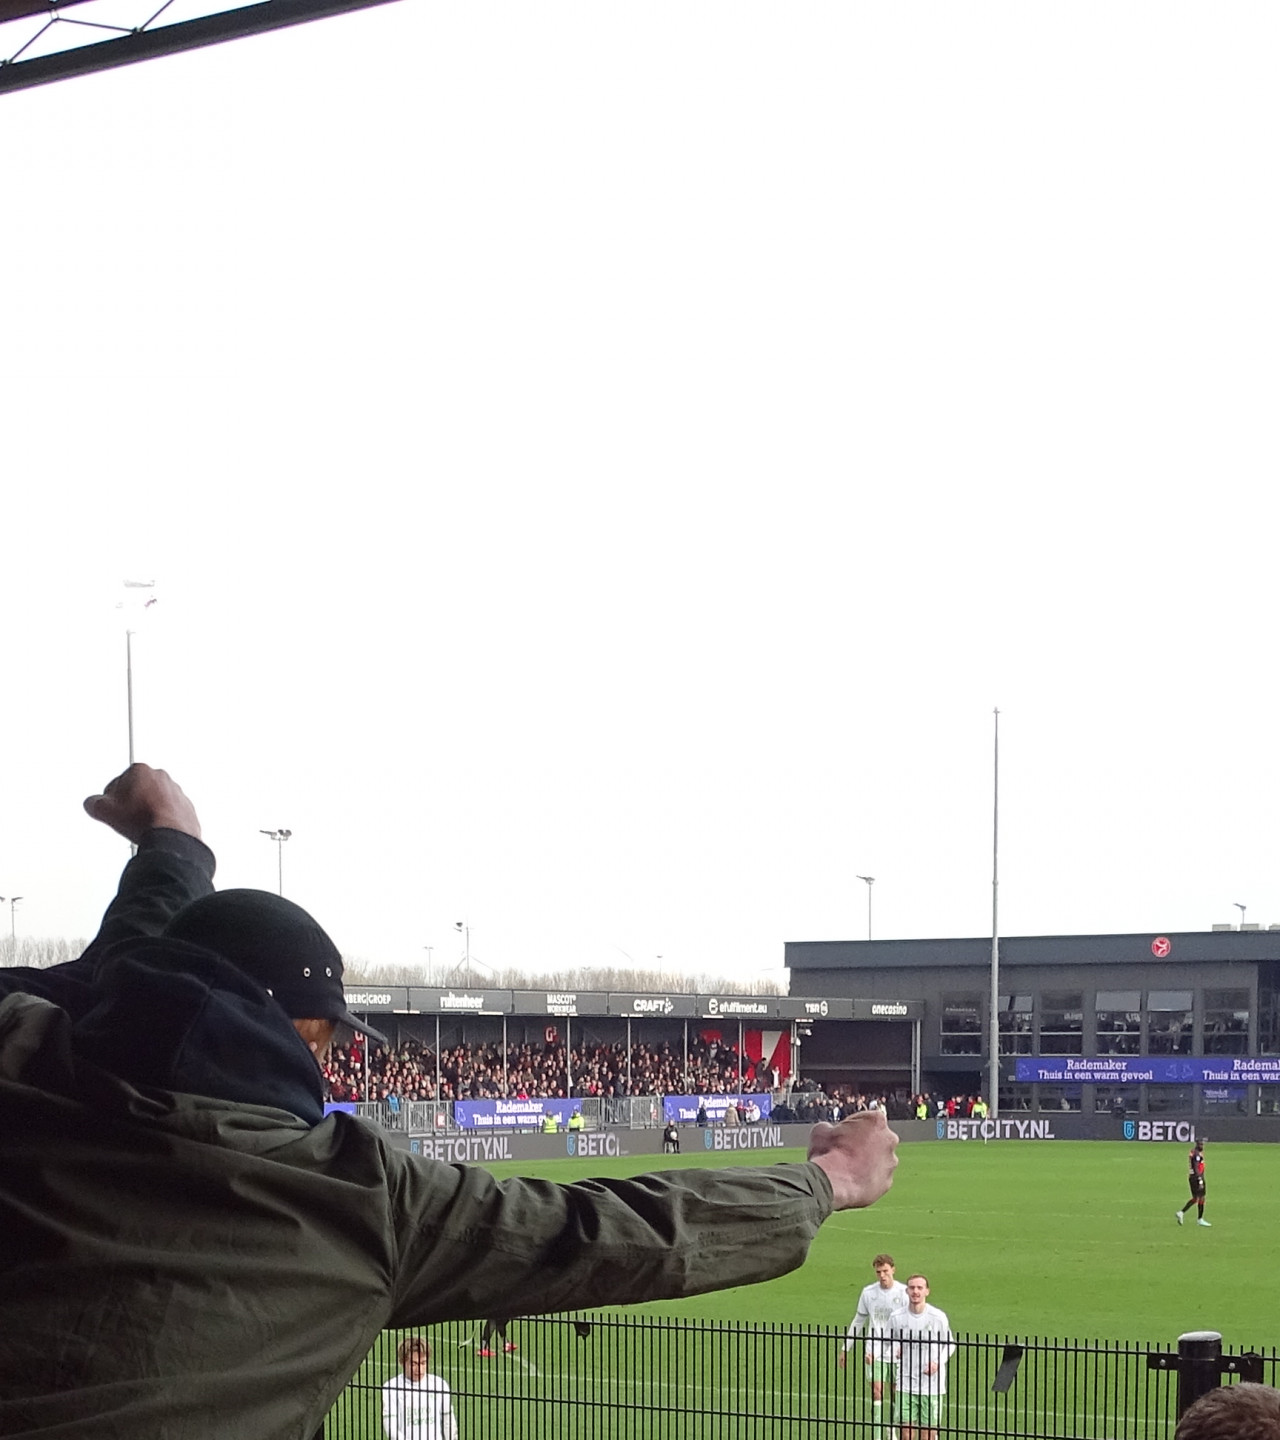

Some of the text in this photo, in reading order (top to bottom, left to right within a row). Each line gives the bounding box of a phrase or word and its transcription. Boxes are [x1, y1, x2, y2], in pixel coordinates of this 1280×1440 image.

[633, 999, 664, 1013] CRAFT
[805, 1003, 820, 1014] TSR
[871, 1002, 908, 1016] onecasino
[1066, 1059, 1127, 1070] Rademaker
[1038, 1070, 1153, 1082] Thuis in een warm gevoel
[1202, 1070, 1228, 1081] Thuis
[1230, 1070, 1240, 1081] in
[1242, 1072, 1261, 1081] een
[495, 1100, 543, 1113] Rademaker
[472, 1113, 493, 1125] Thuis
[494, 1113, 502, 1125] in
[502, 1115, 516, 1125] een
[517, 1113, 537, 1124] warm
[947, 1119, 1055, 1140] BETCITY.NL
[714, 1127, 785, 1150] BETCITY.NL
[423, 1136, 513, 1162] BETCITY.NL
